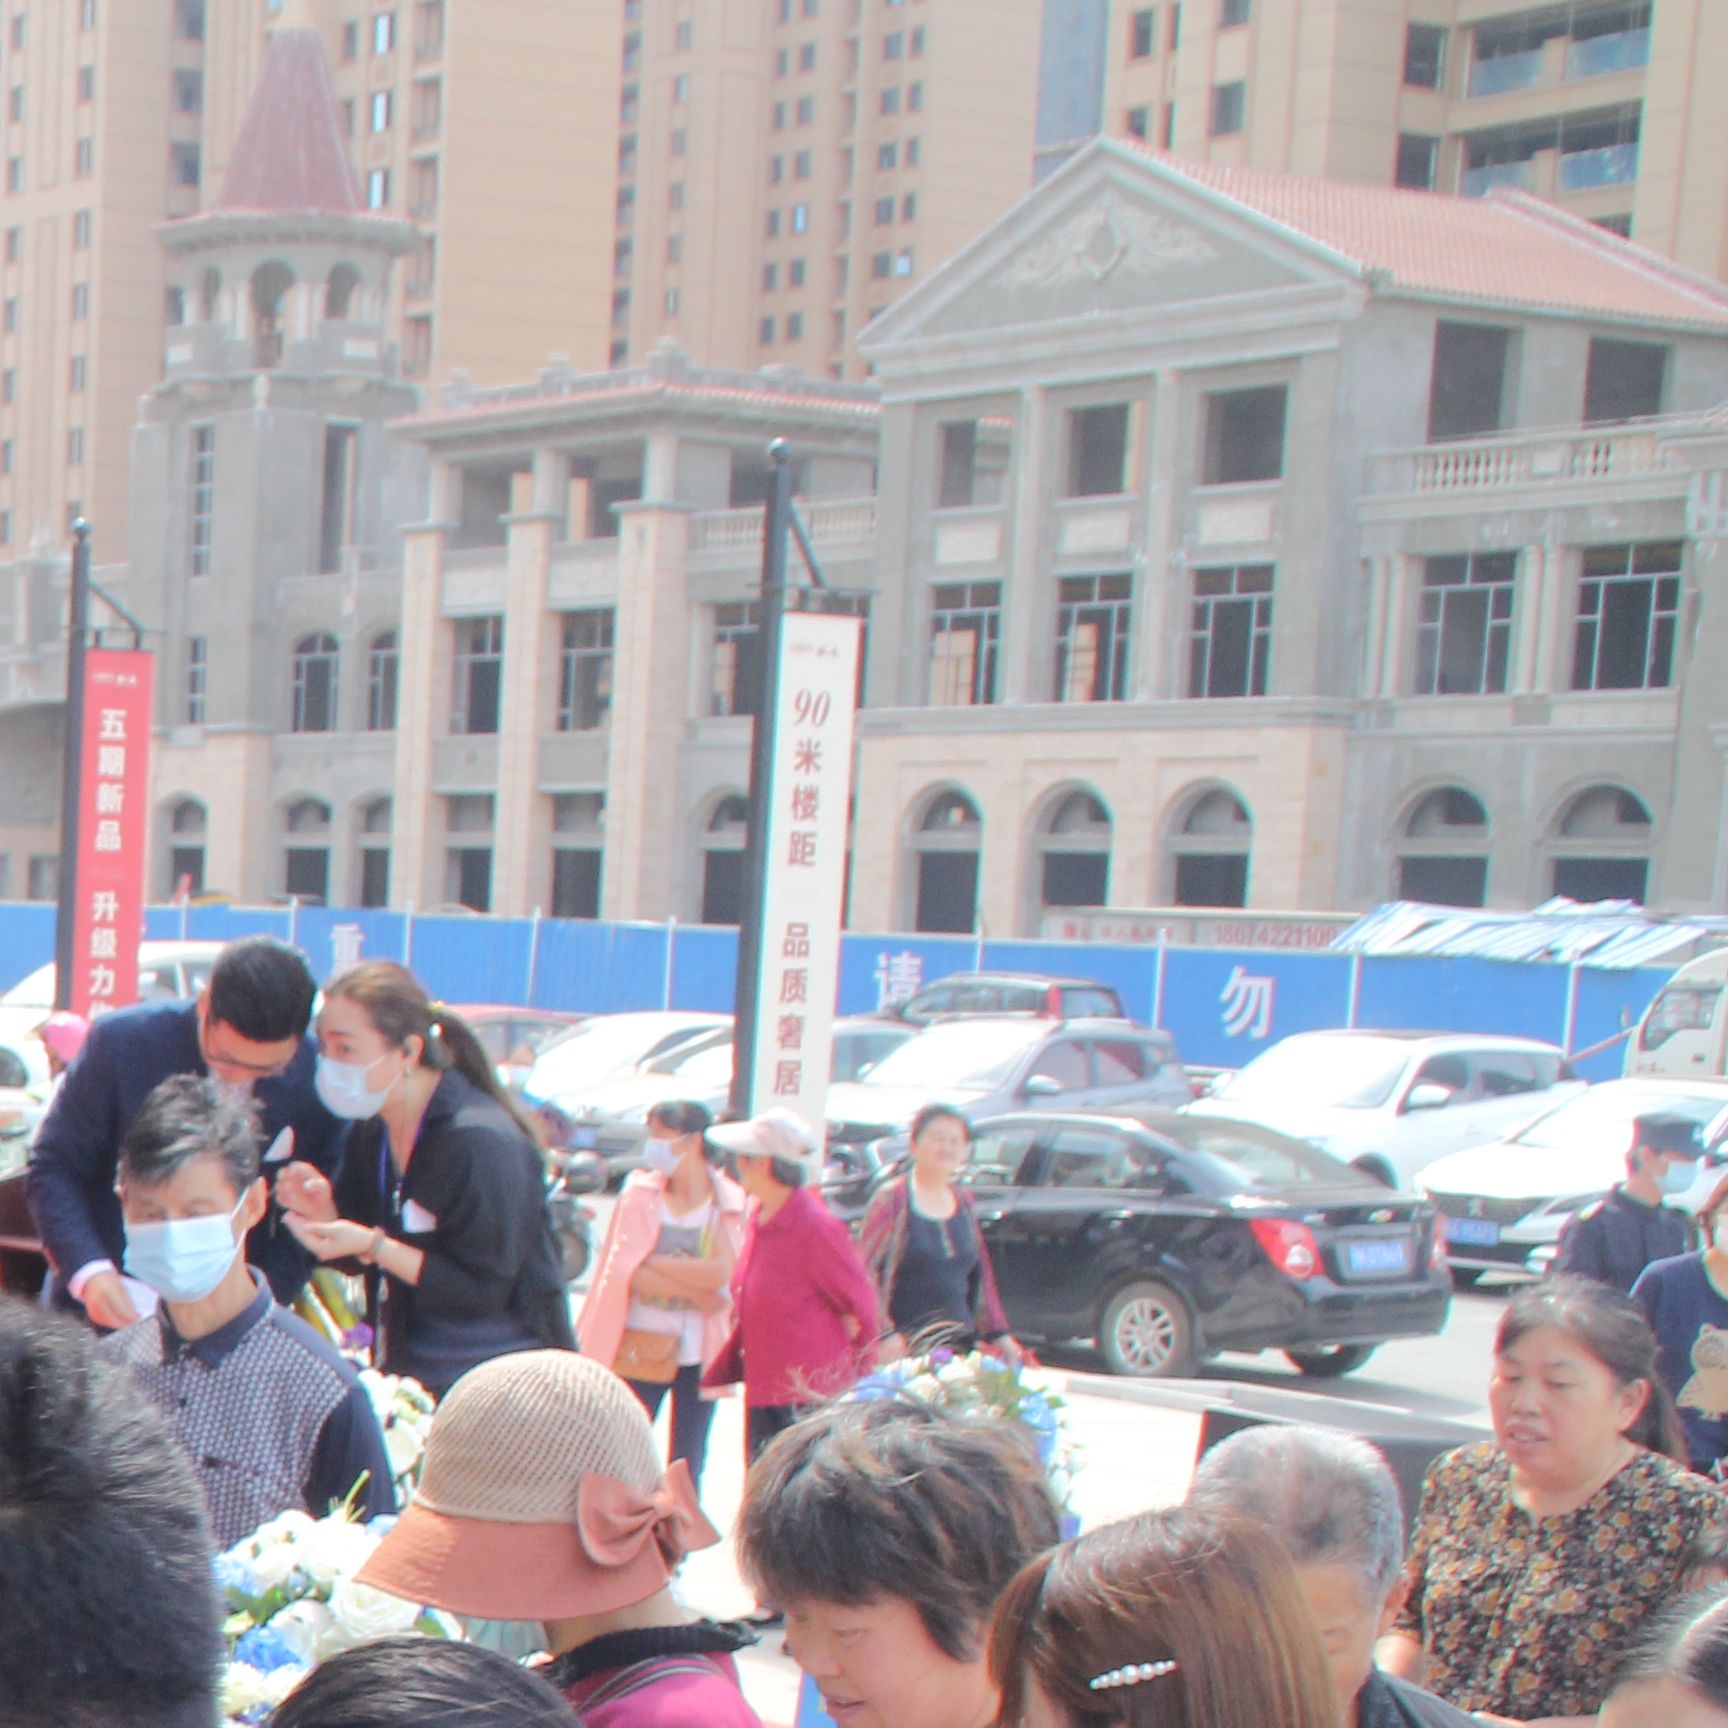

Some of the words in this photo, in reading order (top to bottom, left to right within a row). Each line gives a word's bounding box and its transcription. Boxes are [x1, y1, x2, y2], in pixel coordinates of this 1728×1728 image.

[95, 708, 127, 852] 五期新品
[786, 687, 832, 868] 90米楼距
[774, 921, 810, 1097] 品质奢居
[1220, 965, 1276, 1040] 勿
